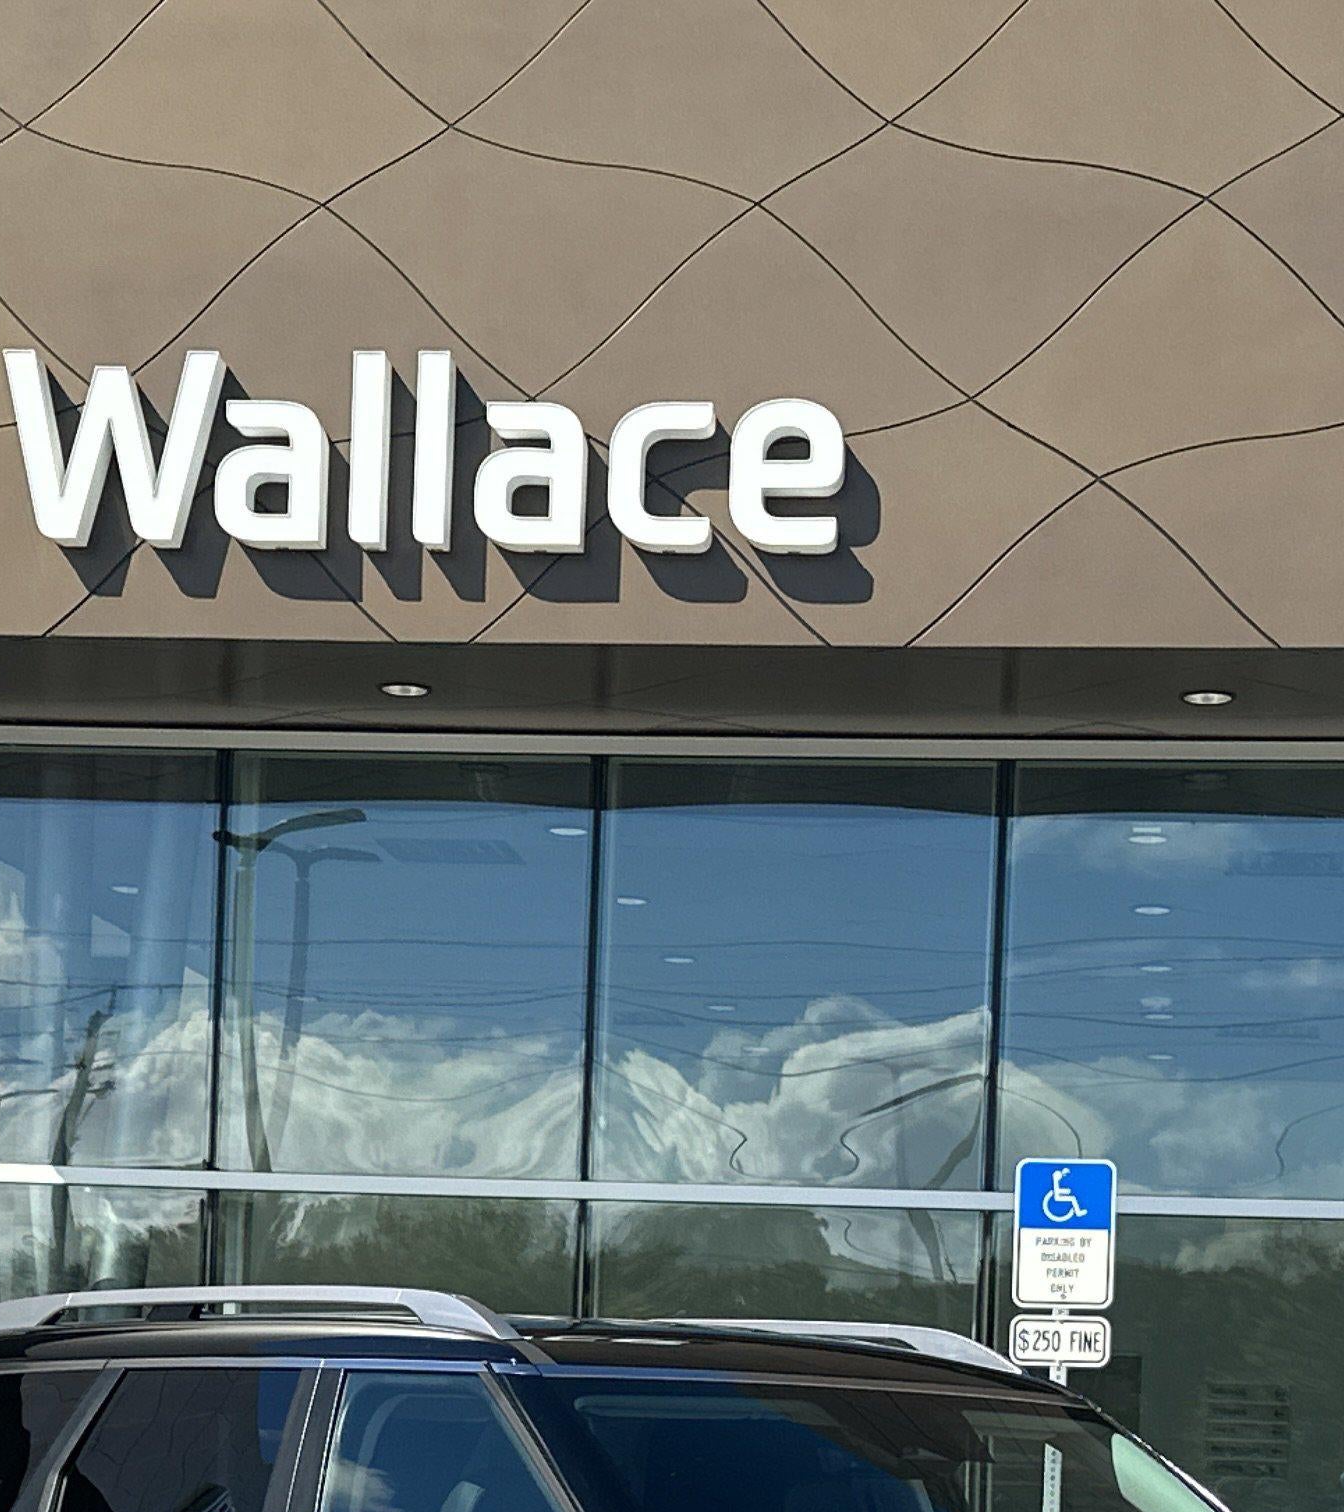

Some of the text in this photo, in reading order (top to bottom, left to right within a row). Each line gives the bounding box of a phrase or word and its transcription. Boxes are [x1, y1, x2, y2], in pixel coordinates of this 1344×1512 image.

[2, 348, 846, 555] Wallace
[1018, 1328, 1102, 1354] $250 FINE
